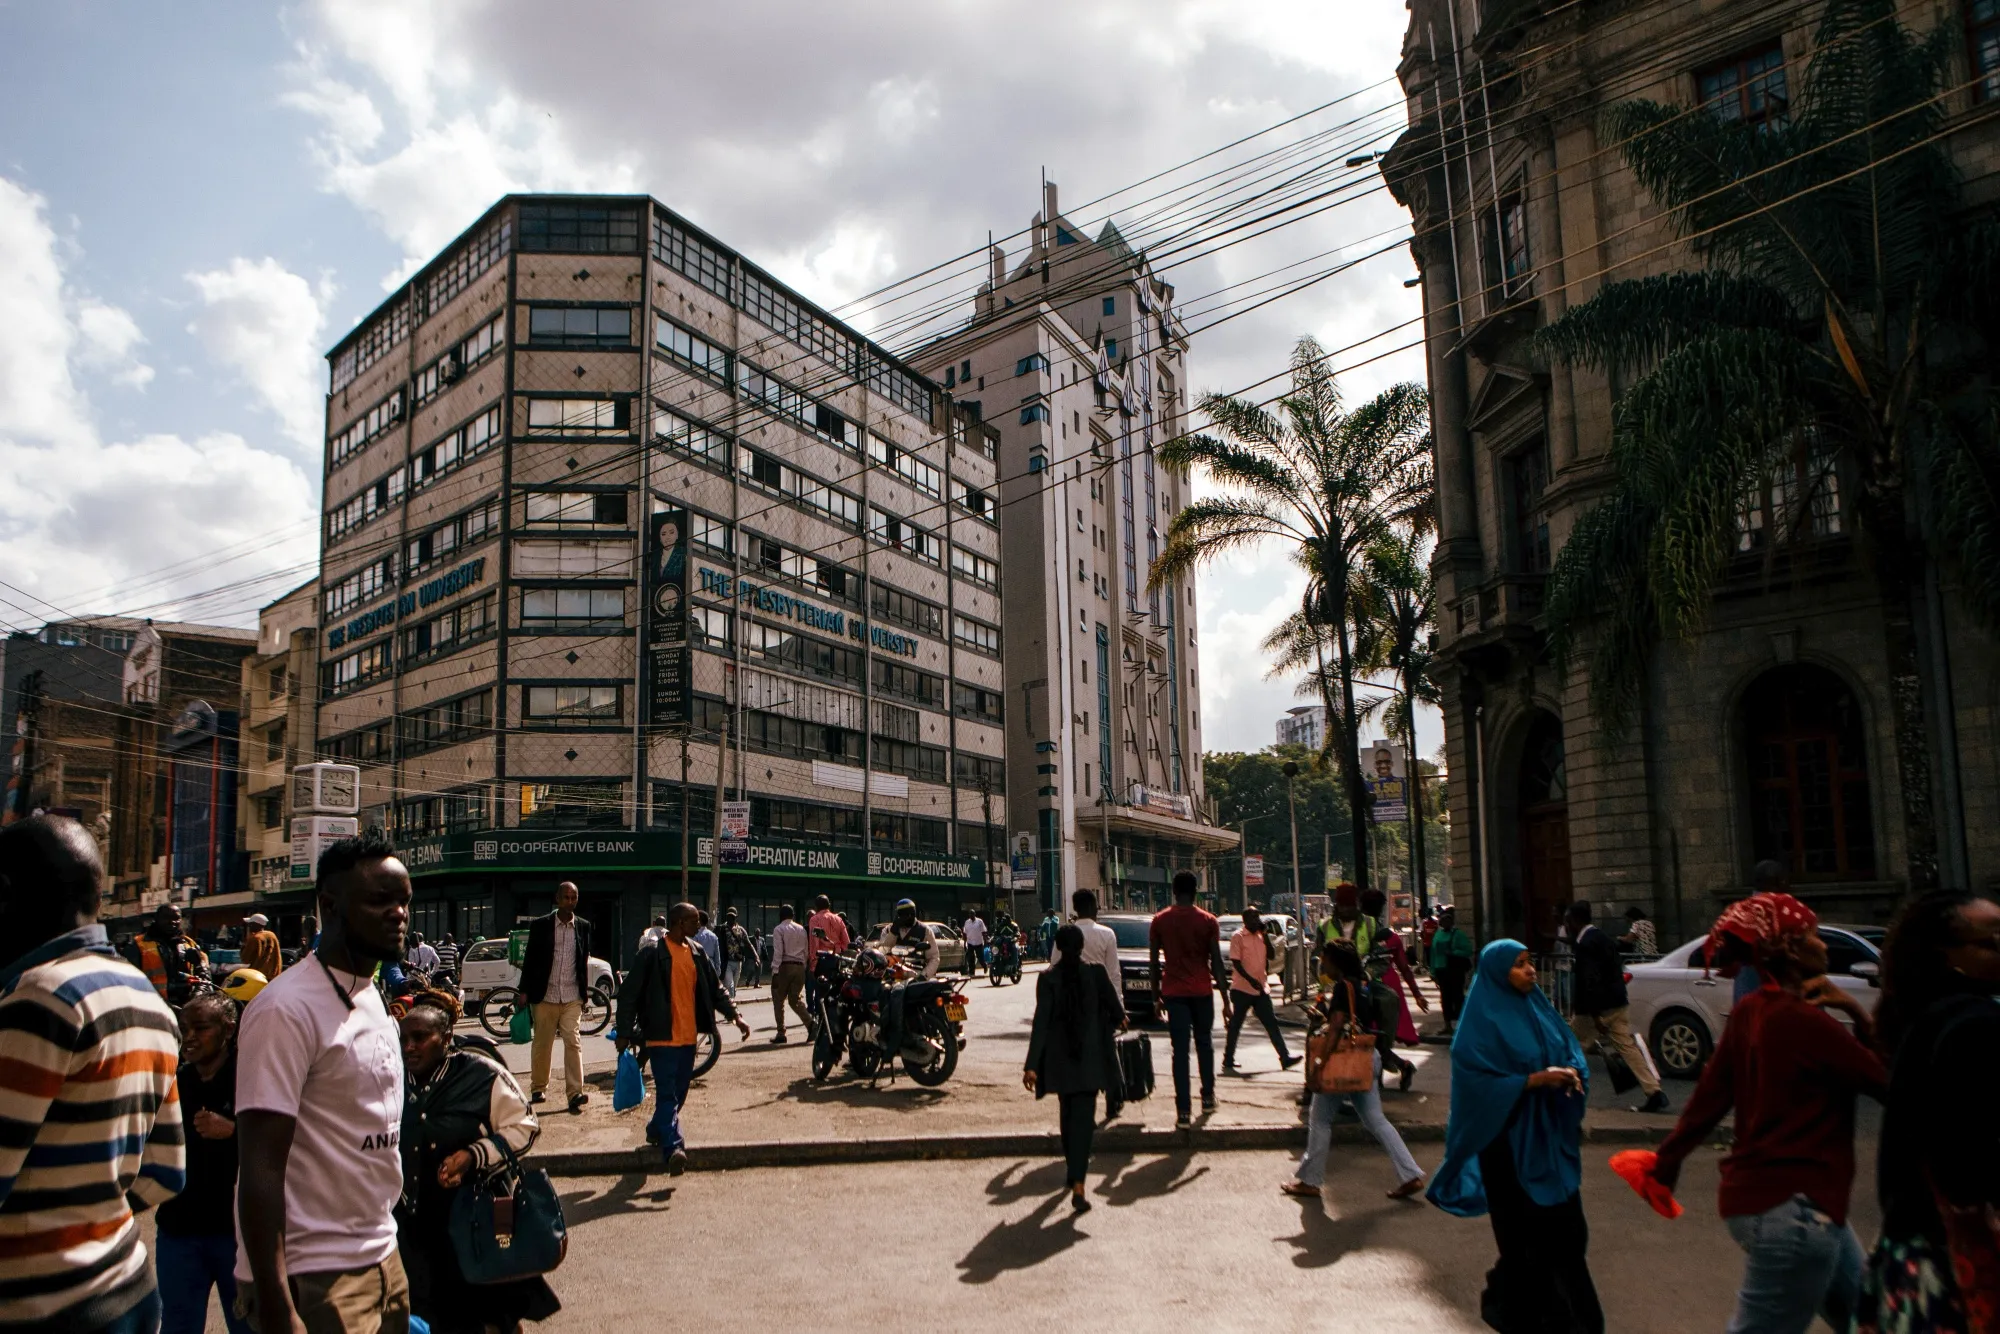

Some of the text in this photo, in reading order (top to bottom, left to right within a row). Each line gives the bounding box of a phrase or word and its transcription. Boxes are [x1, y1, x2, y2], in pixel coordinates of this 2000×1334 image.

[419, 557, 485, 609] UNIVERSITY
[699, 567, 733, 598] THE
[848, 618, 919, 659] UNVERSITY
[657, 690, 680, 698] SUNDAY
[417, 843, 445, 866] BANK
[501, 841, 635, 854] CO-OPERATIVE BANK
[808, 851, 840, 869] BANK
[883, 857, 971, 878] CO-OPERATIVE BANK
